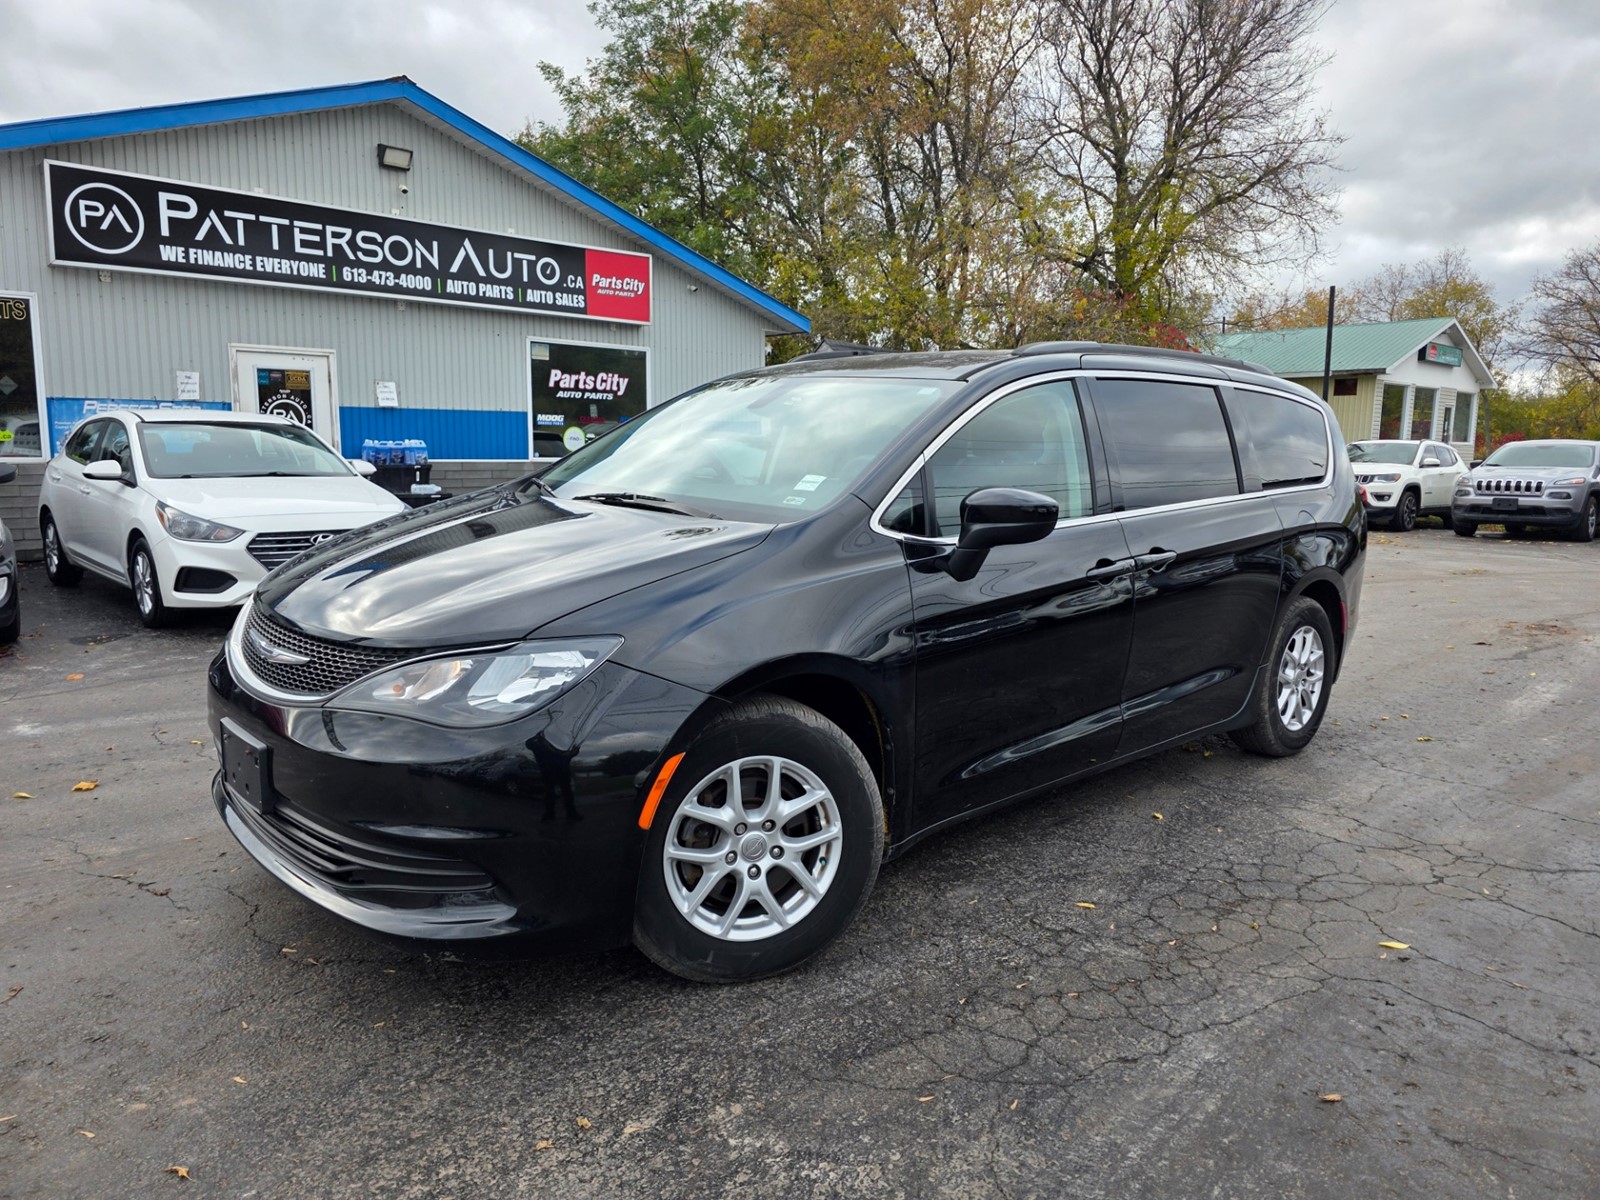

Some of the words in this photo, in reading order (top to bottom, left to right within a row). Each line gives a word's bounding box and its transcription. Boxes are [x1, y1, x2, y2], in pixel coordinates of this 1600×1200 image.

[79, 199, 133, 233] PA
[158, 191, 439, 270] PATTERSON
[159, 244, 186, 263] WE
[189, 248, 253, 270] FINANCE
[255, 256, 326, 279] EVERYONE
[342, 266, 432, 291] 613-473-4000
[446, 279, 476, 296] AUTO
[478, 283, 514, 300] PARTS
[526, 289, 554, 304] AUTO
[555, 292, 585, 308] SALES
[615, 290, 635, 298] PARTS
[0, 299, 27, 321] TS
[556, 391, 582, 399] AUTO
[584, 392, 614, 400] PARTS
[537, 414, 565, 422] MOOG
